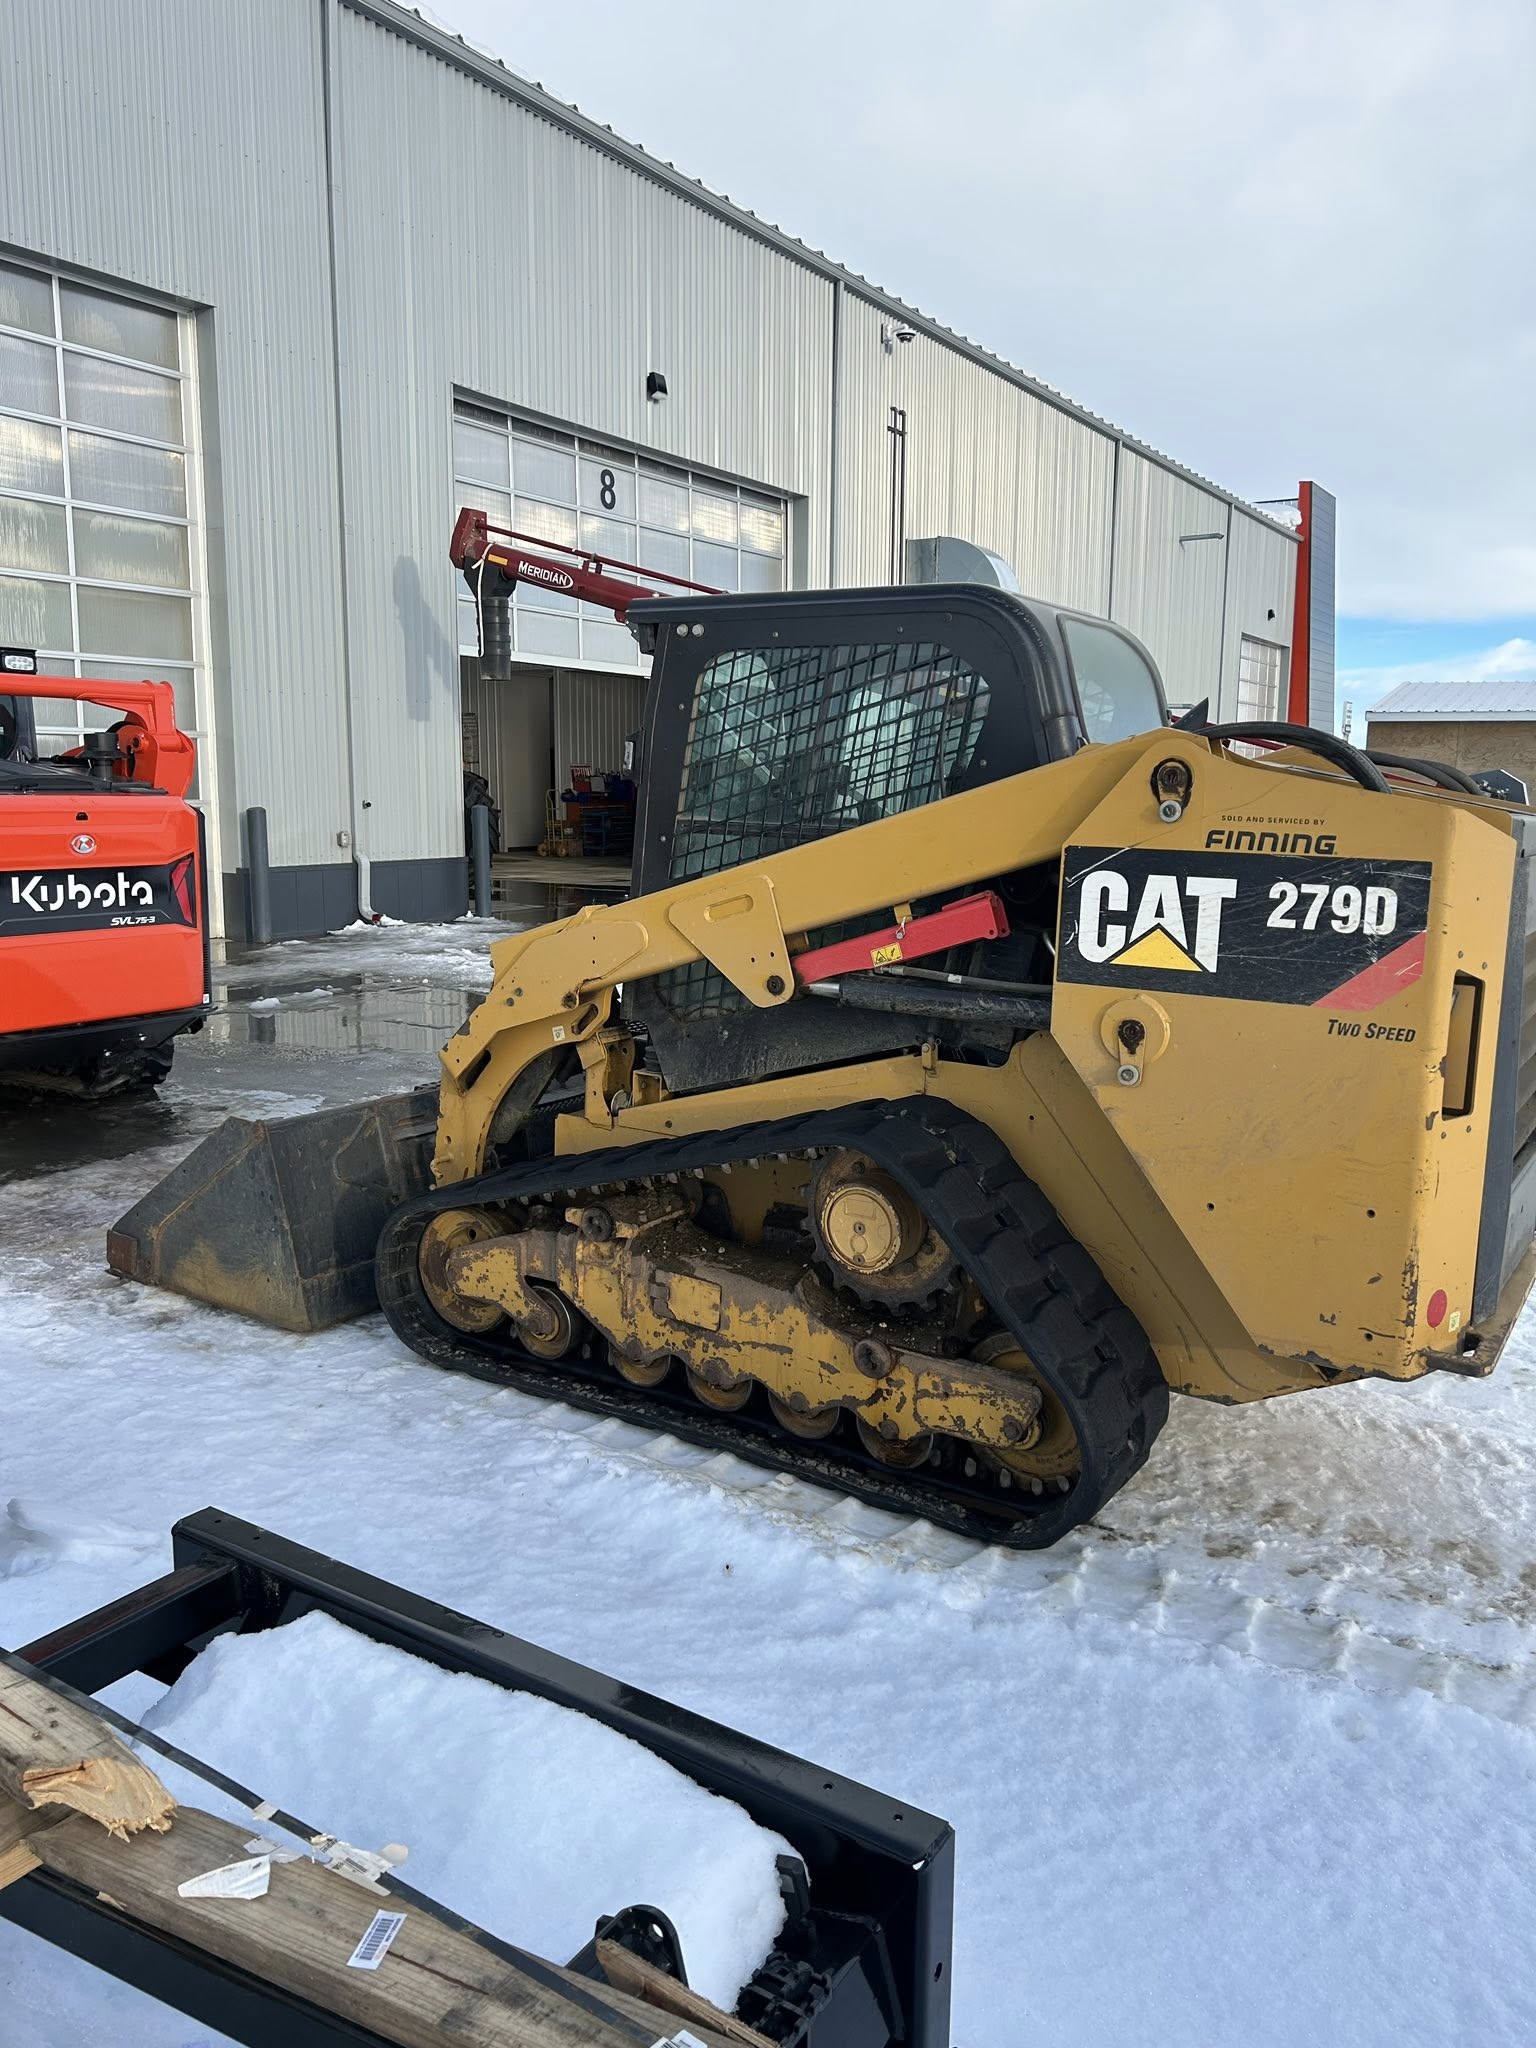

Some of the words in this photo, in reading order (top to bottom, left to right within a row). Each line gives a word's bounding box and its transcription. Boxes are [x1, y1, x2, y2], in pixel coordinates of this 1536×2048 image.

[600, 469, 616, 510] 8
[518, 560, 567, 586] MERIDIAN
[1205, 829, 1337, 855] FINNING
[1267, 817, 1310, 825] SERVICED
[1313, 818, 1325, 826] BY
[11, 871, 153, 912] Kubota
[1266, 881, 1398, 937] 279D
[1077, 870, 1238, 973] CAT
